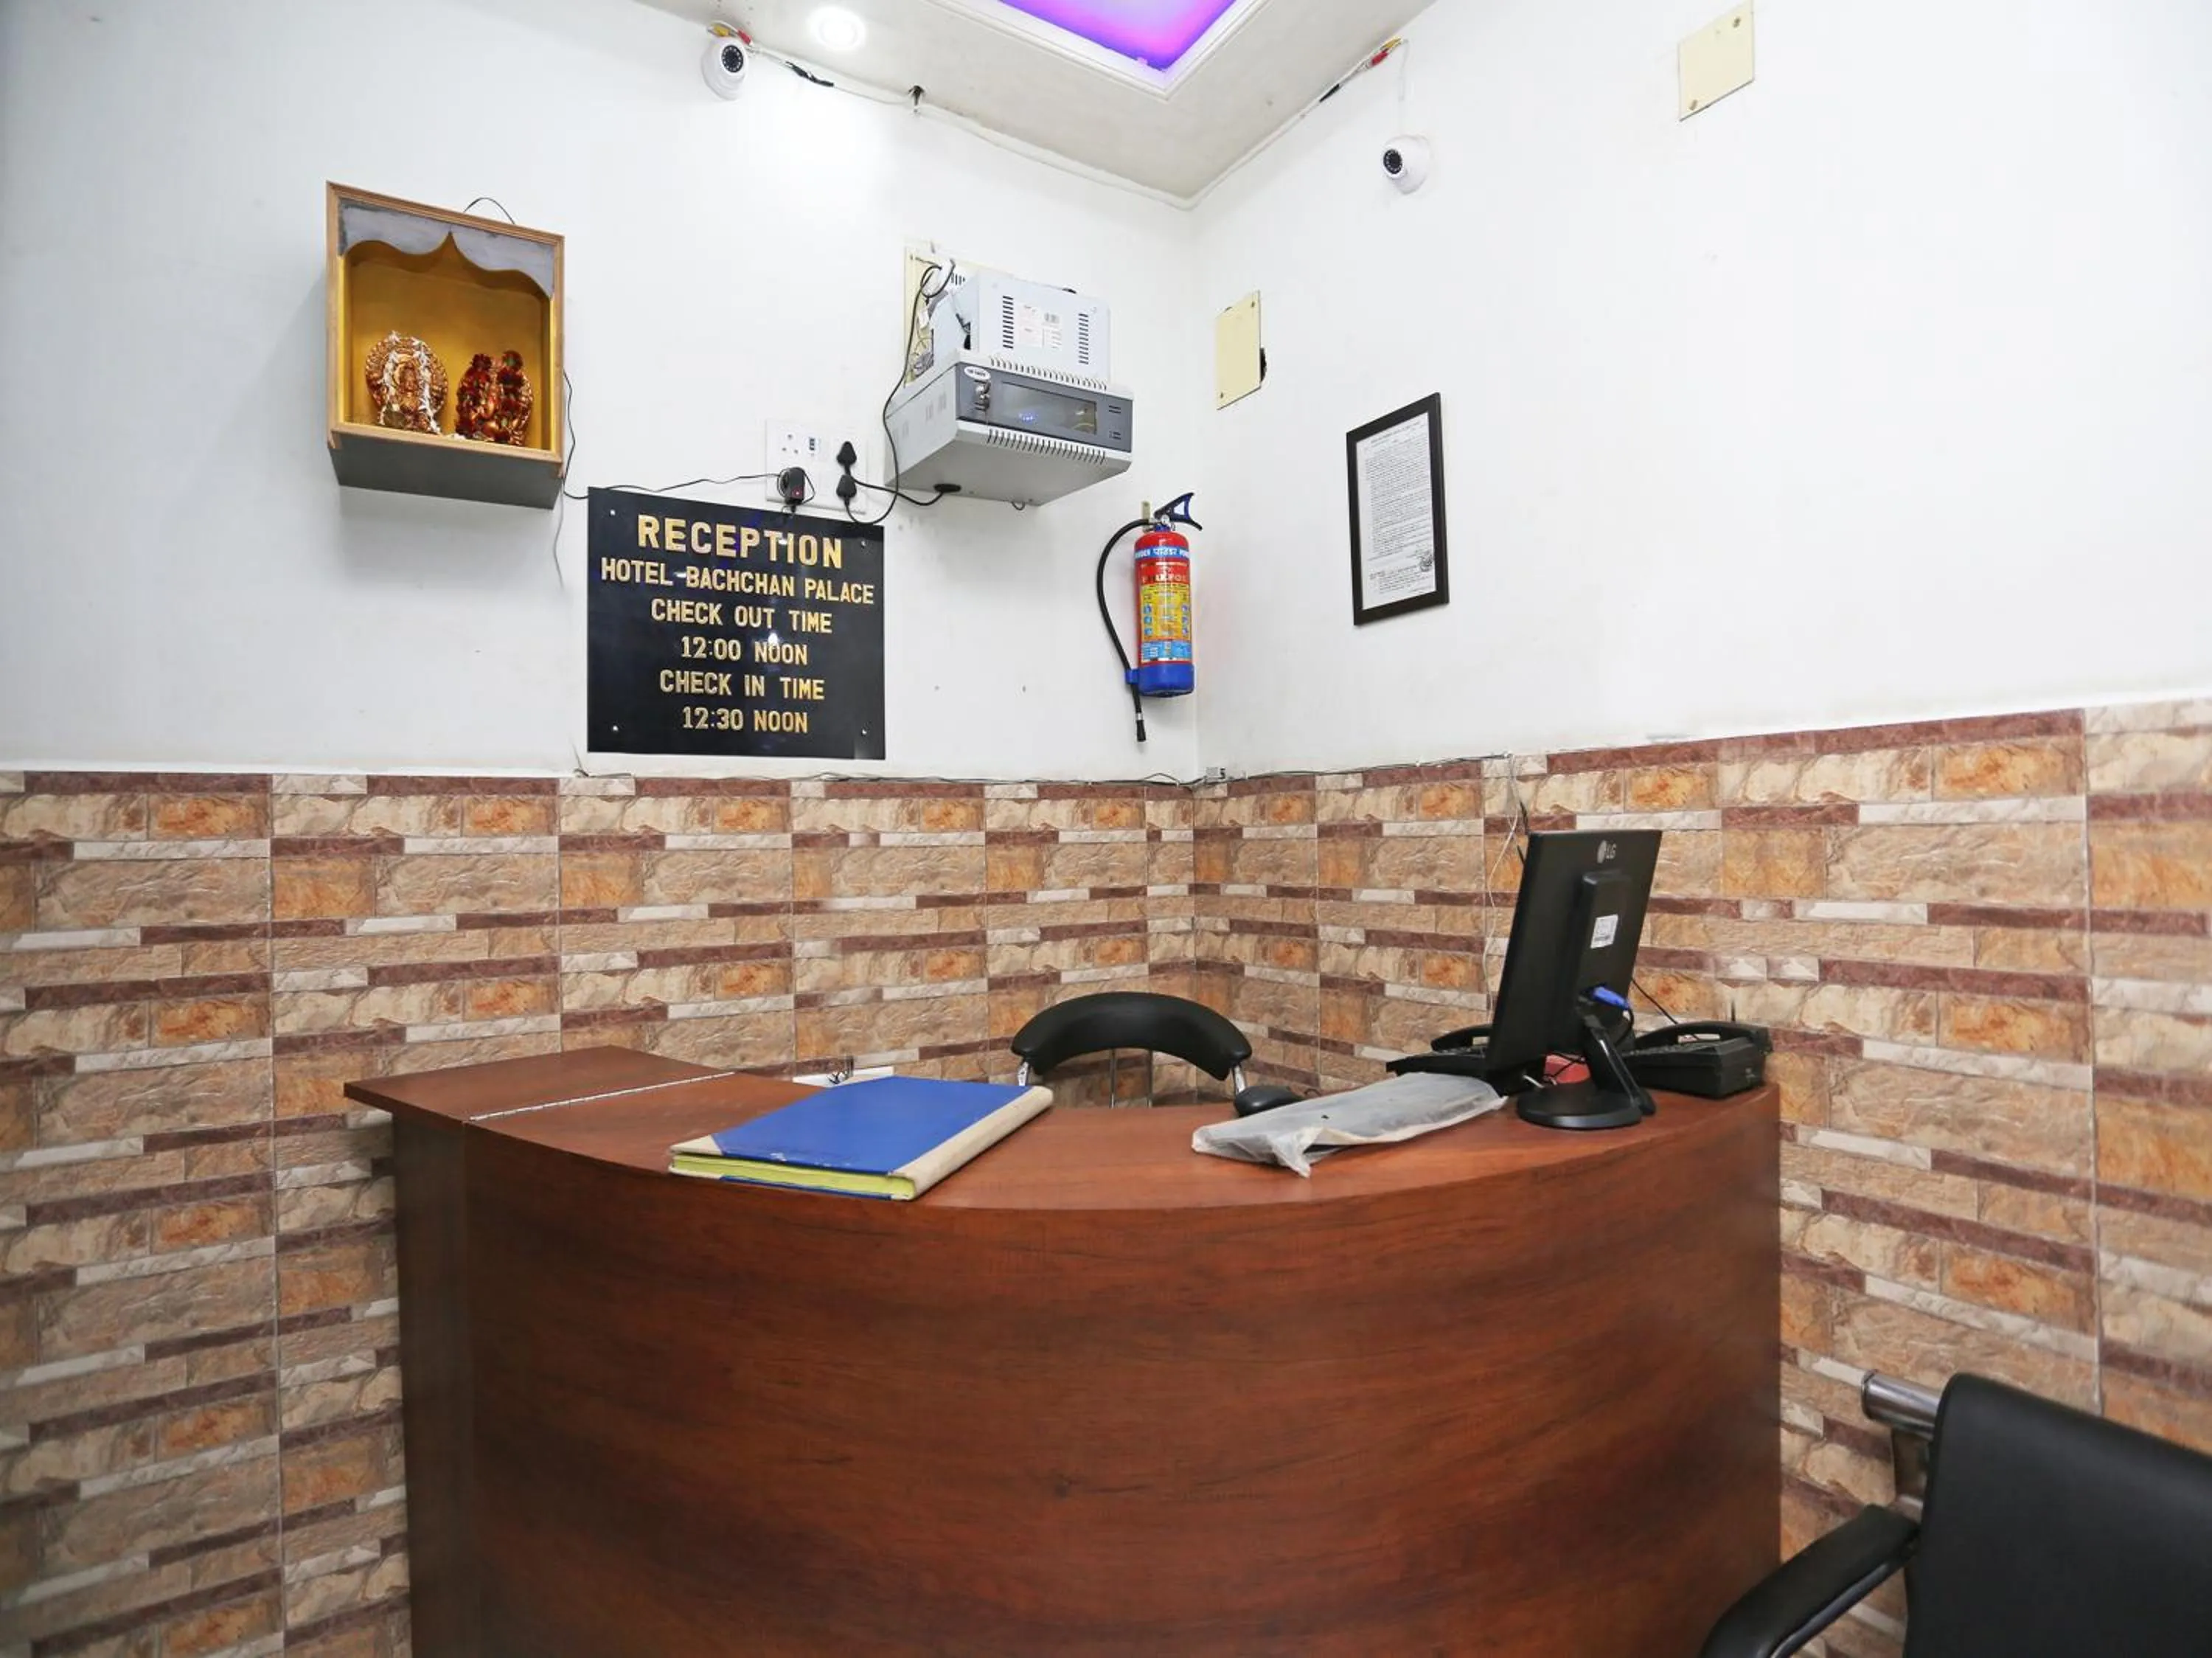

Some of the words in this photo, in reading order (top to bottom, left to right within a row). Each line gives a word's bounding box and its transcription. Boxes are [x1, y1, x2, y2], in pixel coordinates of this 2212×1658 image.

[638, 515, 843, 569] RECEPTION
[804, 579, 874, 605] PALACE
[651, 598, 723, 626] CHECK
[734, 606, 775, 629] OUT
[788, 610, 832, 634] TIME
[681, 636, 741, 662] 12:00
[754, 642, 808, 665] NOON
[660, 669, 732, 696] CHECK
[744, 674, 765, 698] IN
[779, 676, 825, 701] TIME
[683, 706, 744, 731] 12:30
[754, 711, 808, 734] NOON
